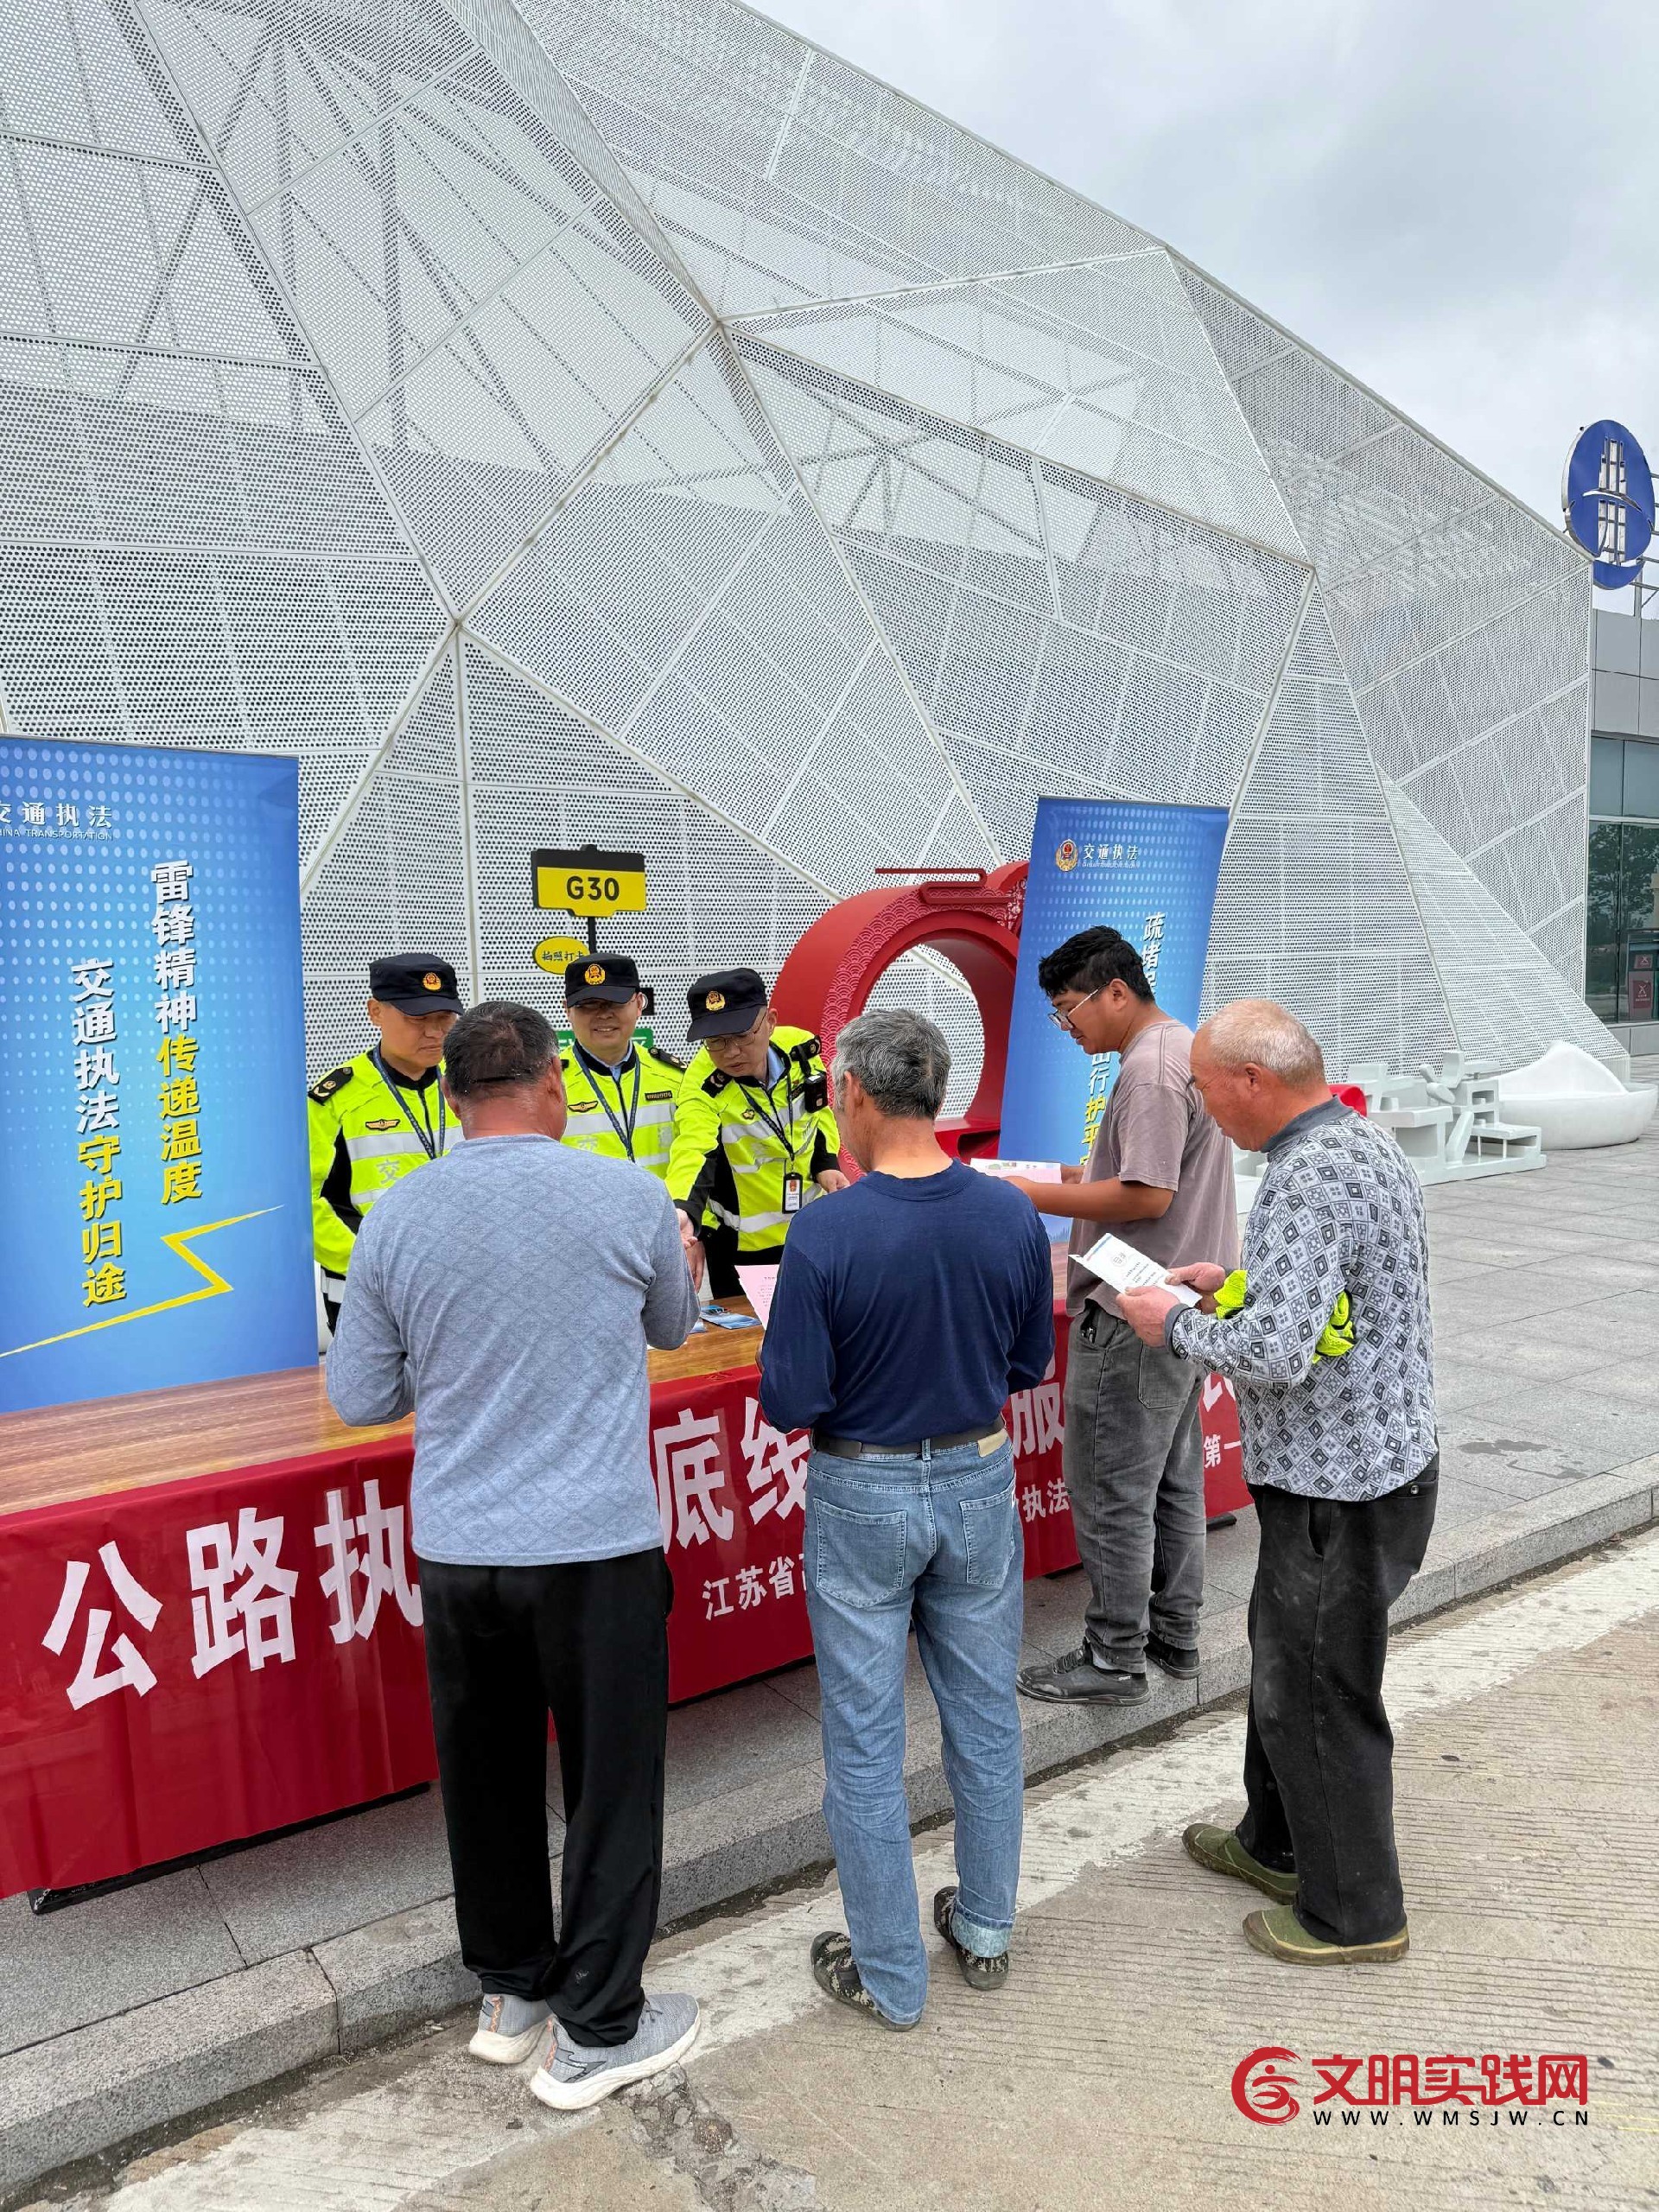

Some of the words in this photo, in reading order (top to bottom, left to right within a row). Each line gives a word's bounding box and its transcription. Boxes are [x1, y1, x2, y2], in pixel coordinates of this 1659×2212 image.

[26, 830, 113, 841] TRANSPORTATION
[566, 875, 620, 901] G30
[1083, 843, 1138, 860] 交通执法
[150, 859, 202, 1206] 雷锋精神传递温度
[72, 957, 127, 1309] 交通执法守护归途
[41, 1478, 424, 1711] 公路执
[653, 1396, 810, 1554] 底线
[702, 1554, 806, 1621] 江苏省
[1021, 1477, 1070, 1523] 执法
[1204, 1434, 1242, 1468] 第一
